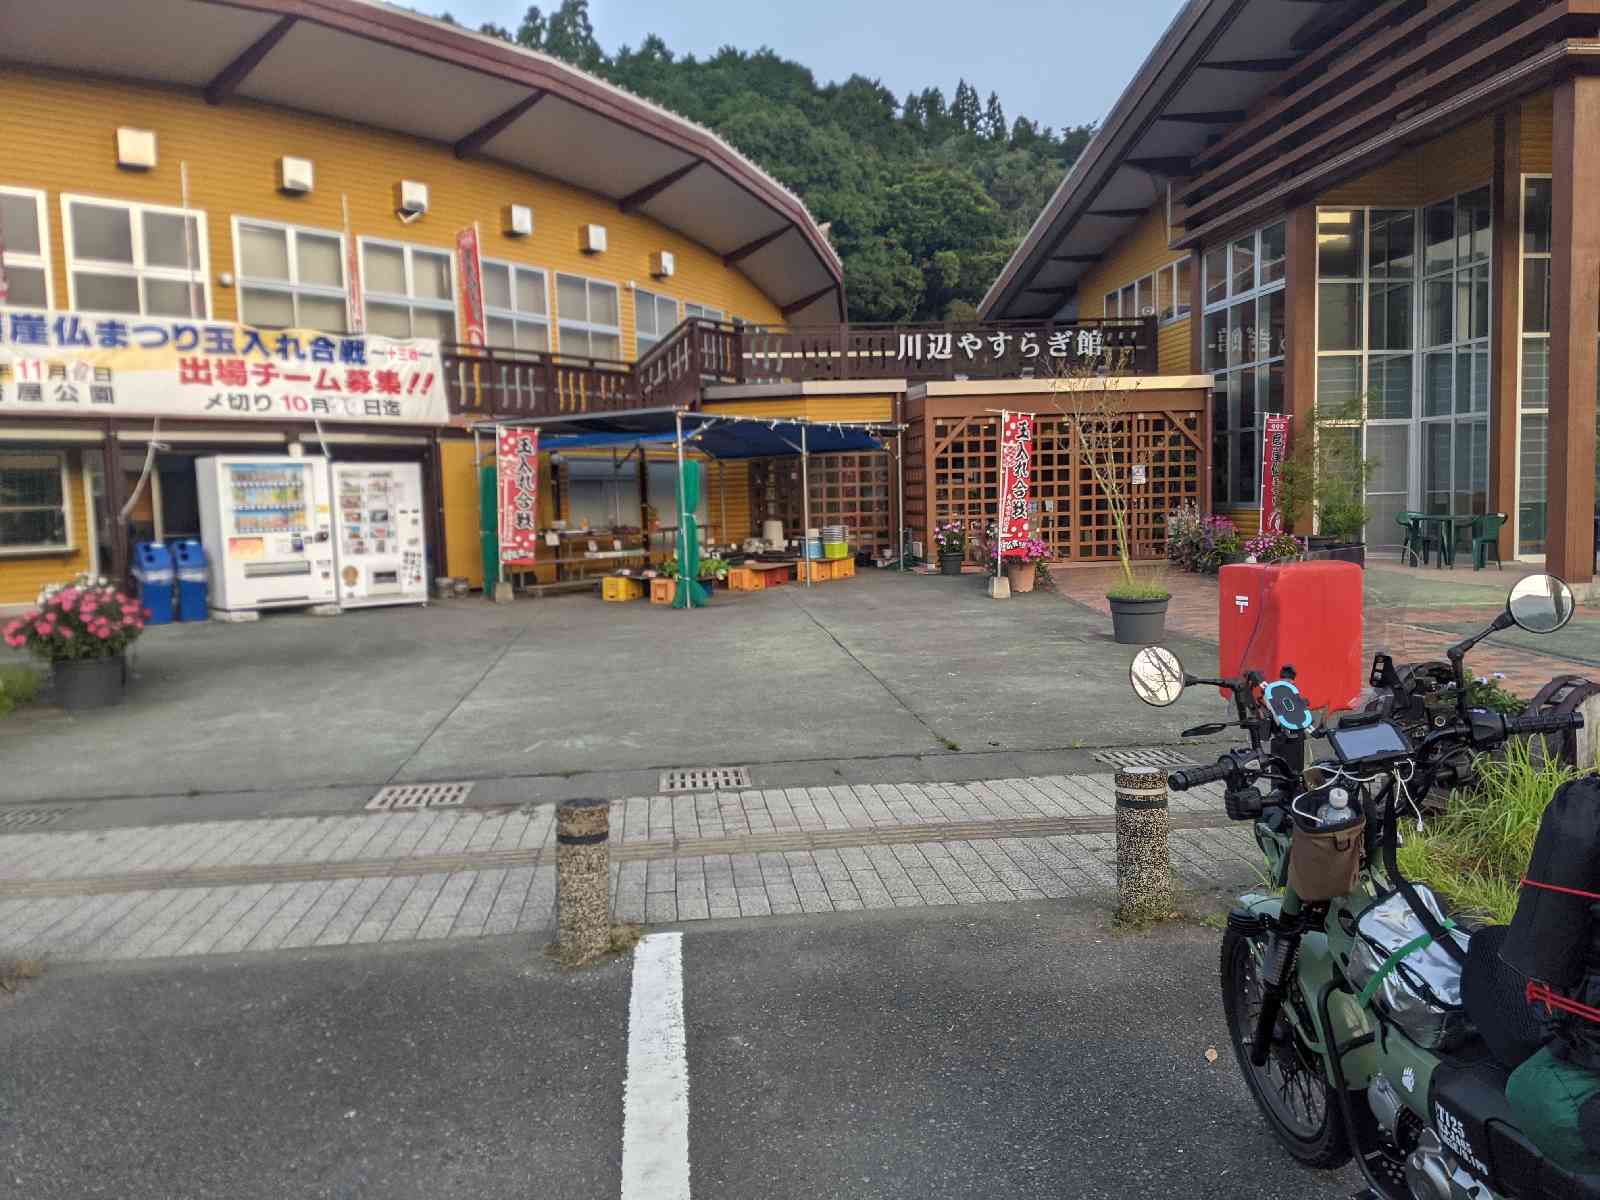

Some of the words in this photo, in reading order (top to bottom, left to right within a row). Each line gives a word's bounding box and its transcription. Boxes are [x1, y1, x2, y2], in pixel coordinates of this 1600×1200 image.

[0, 313, 366, 365] 崖仏まつり玉入れ合戦
[897, 329, 1103, 360] 川辺やすらぎ館
[0, 382, 114, 405] 屋公園
[514, 434, 536, 530] 玉入れ合戦
[1011, 420, 1032, 520] 玉入れ合戦
